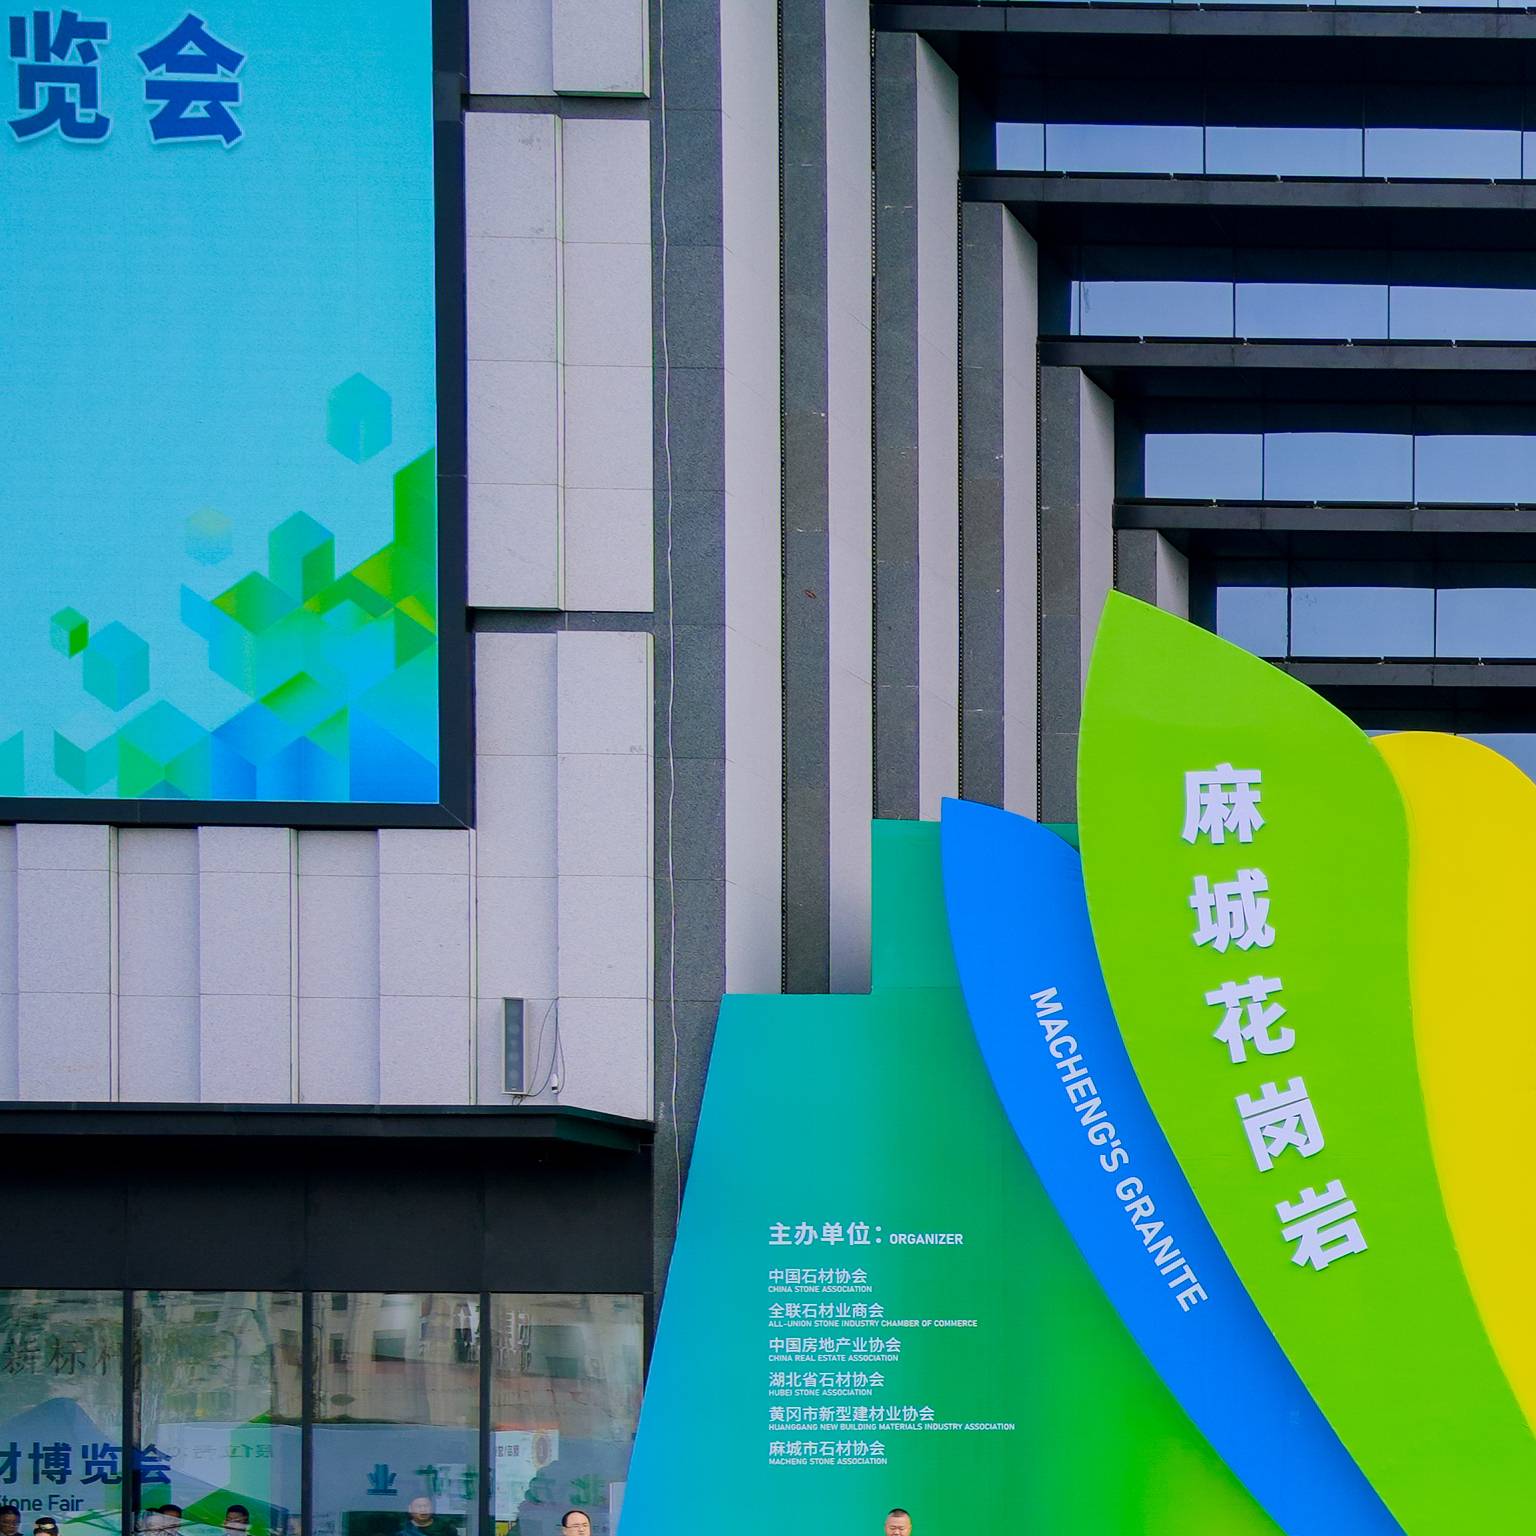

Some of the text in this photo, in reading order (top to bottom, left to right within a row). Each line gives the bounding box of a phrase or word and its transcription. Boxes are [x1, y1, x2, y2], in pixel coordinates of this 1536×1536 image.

[7, 9, 247, 147] 览会
[1181, 762, 1368, 1271] 麻城花岗岩
[1030, 987, 1208, 1312] MACHENG'S GRANITE
[769, 1221, 964, 1245] 主办单位： ORGANIZER
[769, 1268, 867, 1284] 中国石材协会
[769, 1303, 884, 1318] 全联石材业商会
[769, 1337, 901, 1352] 中国房地产业协会
[770, 1372, 884, 1387] 湖北省石材协会
[769, 1406, 934, 1422] 黄冈市新型建材业协会
[769, 1440, 885, 1456] 麻城市石材协会
[48, 1494, 85, 1512] Fair
